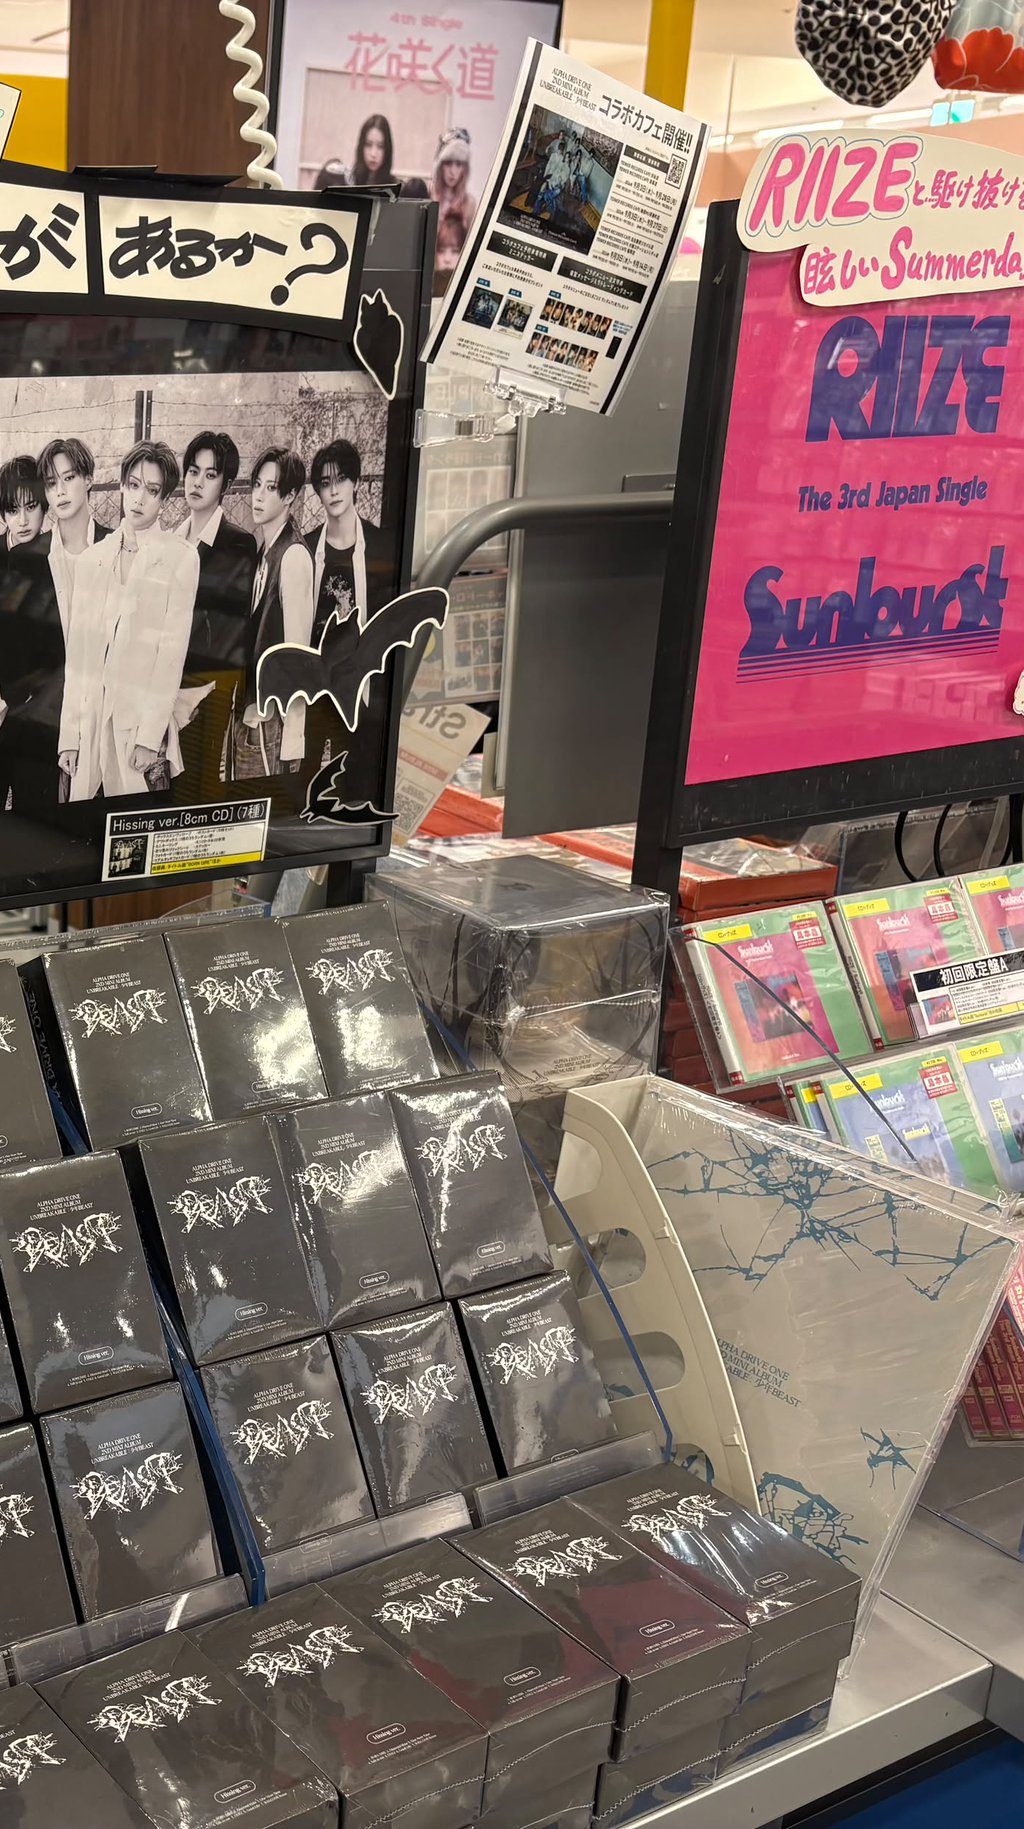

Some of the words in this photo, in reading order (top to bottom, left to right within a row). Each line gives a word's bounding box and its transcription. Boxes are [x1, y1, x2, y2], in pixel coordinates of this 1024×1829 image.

[421, 15, 464, 31] Single
[346, 32, 499, 101] 花咲く道
[805, 315, 1011, 443] RIIZE
[799, 485, 832, 512] The
[837, 482, 872, 509] 3rd
[876, 481, 930, 510] Japan
[935, 475, 988, 506] Single
[738, 545, 1008, 658] Sunburst
[113, 818, 155, 832] Hissing
[939, 956, 1010, 986] 初回限定盤A
[716, 1337, 739, 1355] LPHA
[741, 1350, 769, 1371] DRIVE
[769, 1366, 790, 1380] ONE
[749, 1368, 783, 1388] ALBUM
